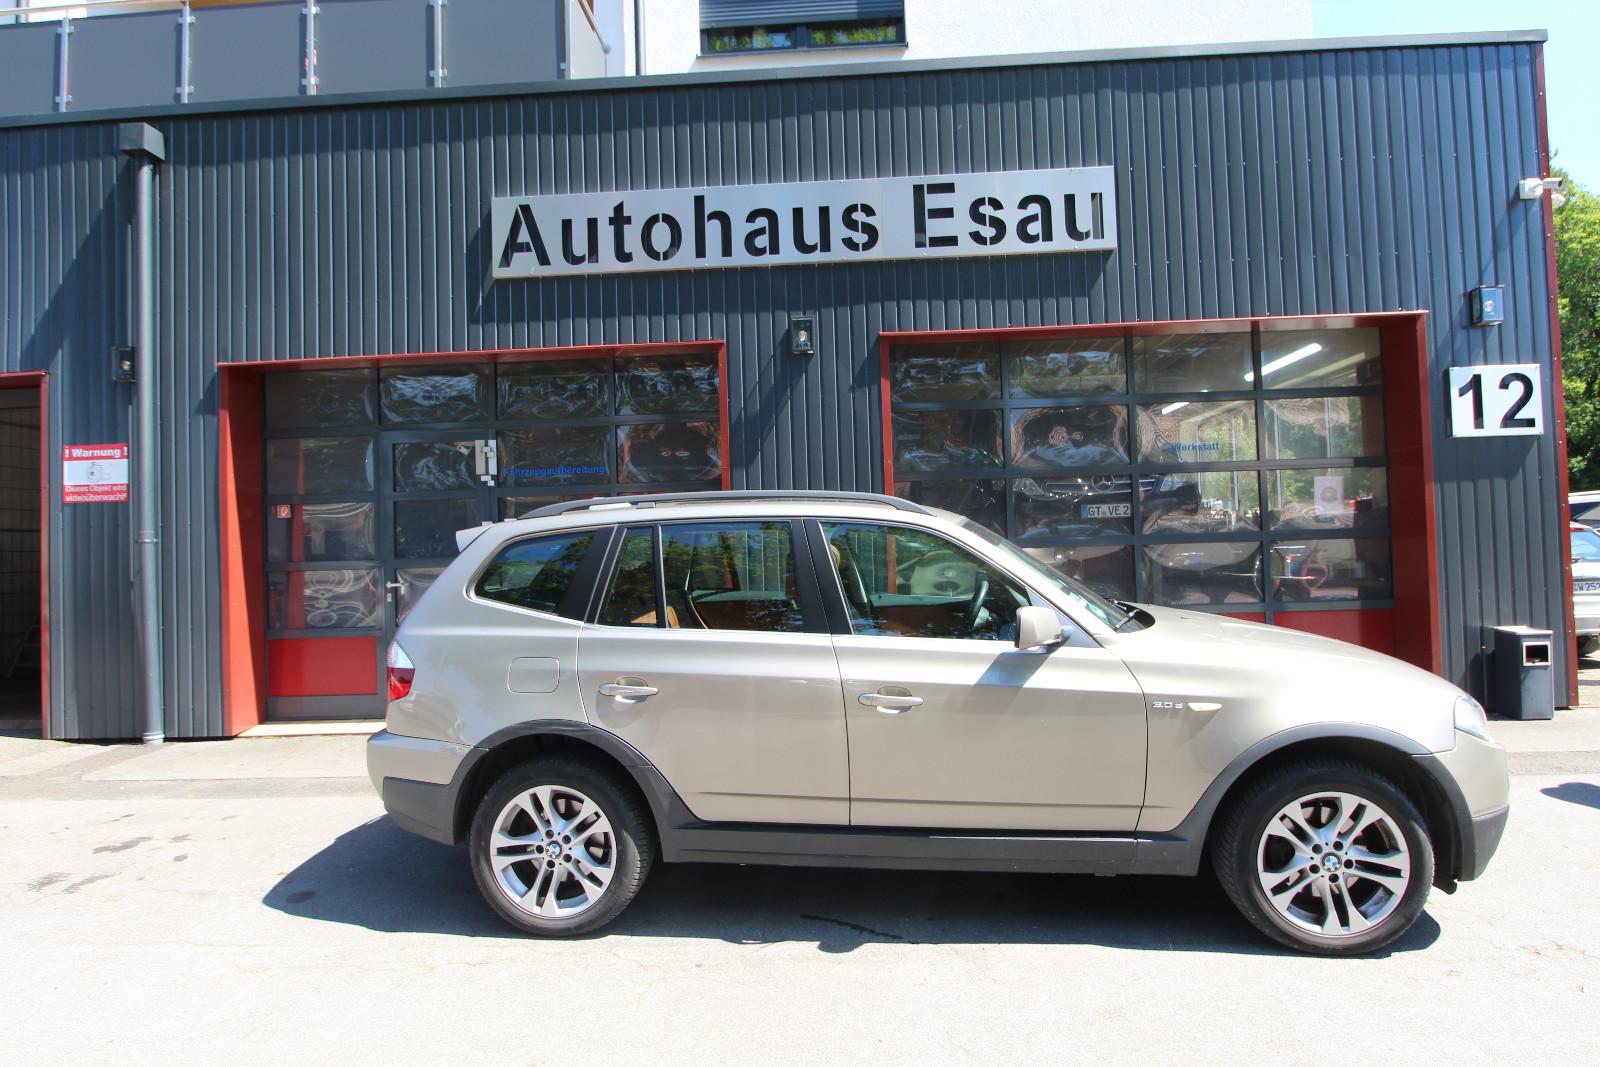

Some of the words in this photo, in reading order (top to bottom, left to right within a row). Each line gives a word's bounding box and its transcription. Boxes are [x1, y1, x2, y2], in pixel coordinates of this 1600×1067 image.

[497, 194, 880, 268] Autohaus
[912, 182, 1105, 250] Esau
[1457, 372, 1536, 430] 12
[71, 448, 121, 458] Warnung
[1170, 442, 1219, 450] Werkstatt
